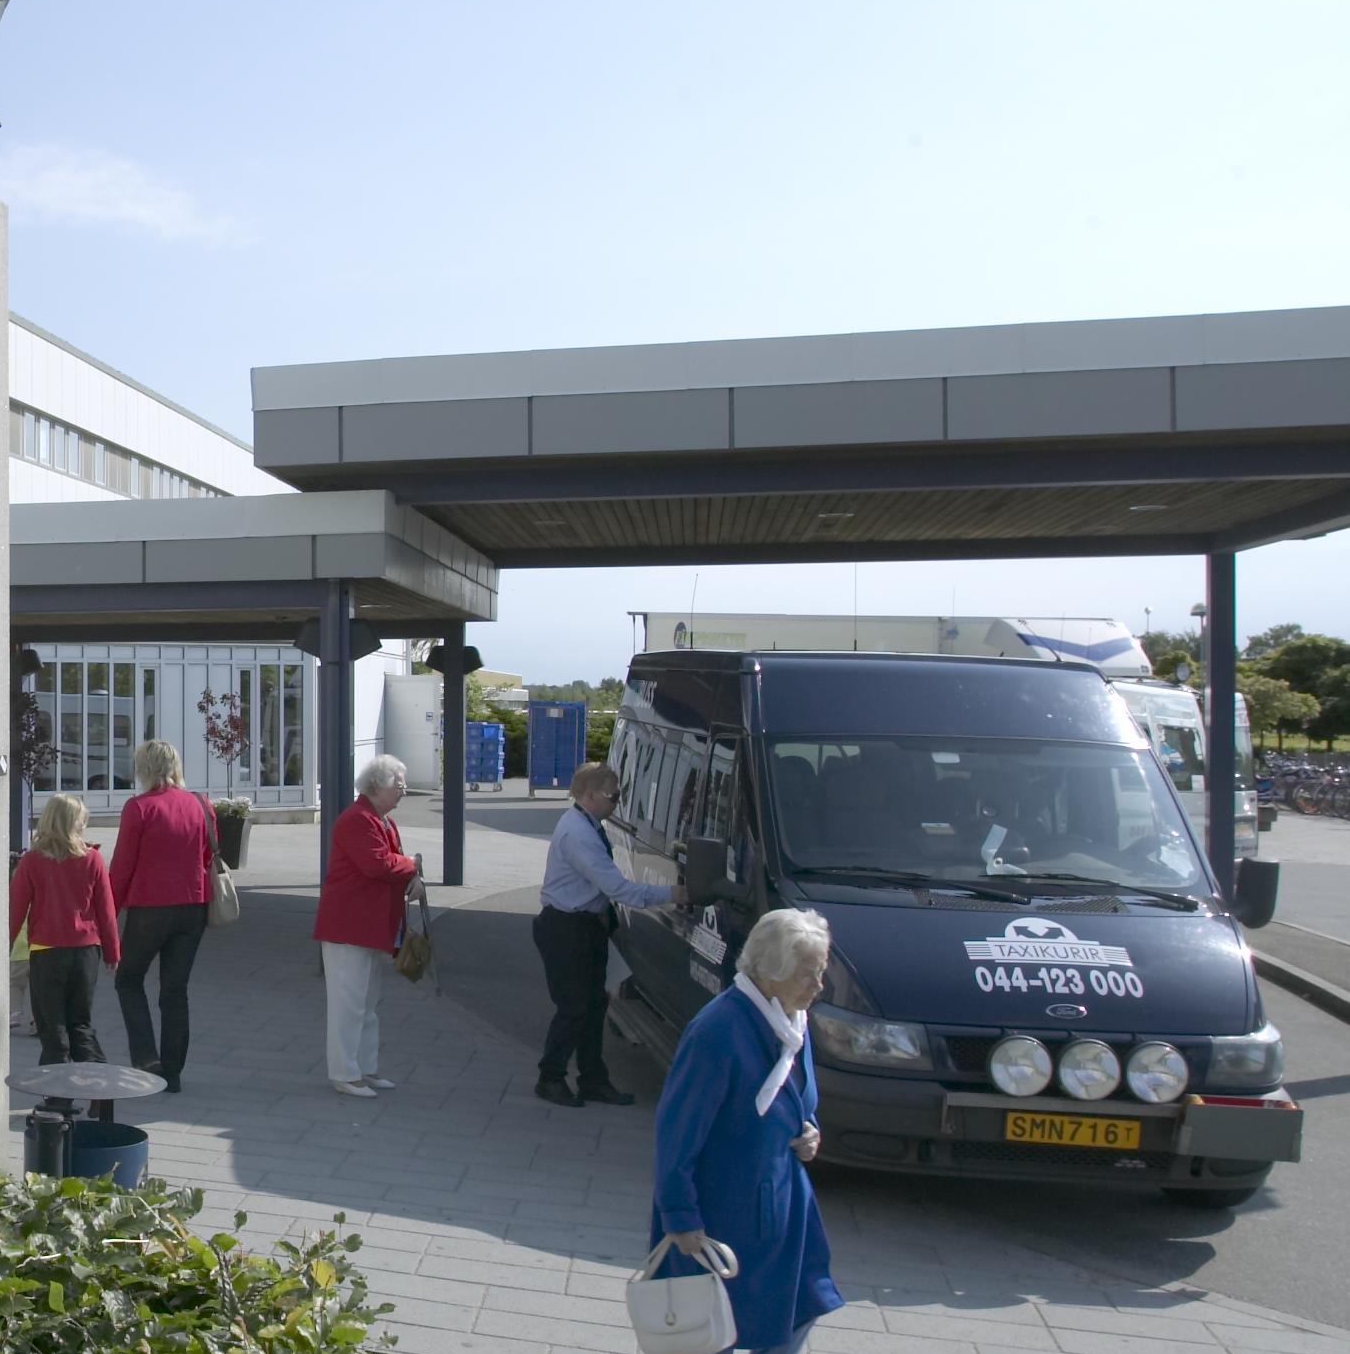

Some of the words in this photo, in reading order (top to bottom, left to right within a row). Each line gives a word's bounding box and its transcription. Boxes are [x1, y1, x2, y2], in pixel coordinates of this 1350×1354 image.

[994, 944, 1103, 961] TAXIKURIR
[975, 966, 1085, 995] 044-123
[1089, 968, 1144, 998] 000
